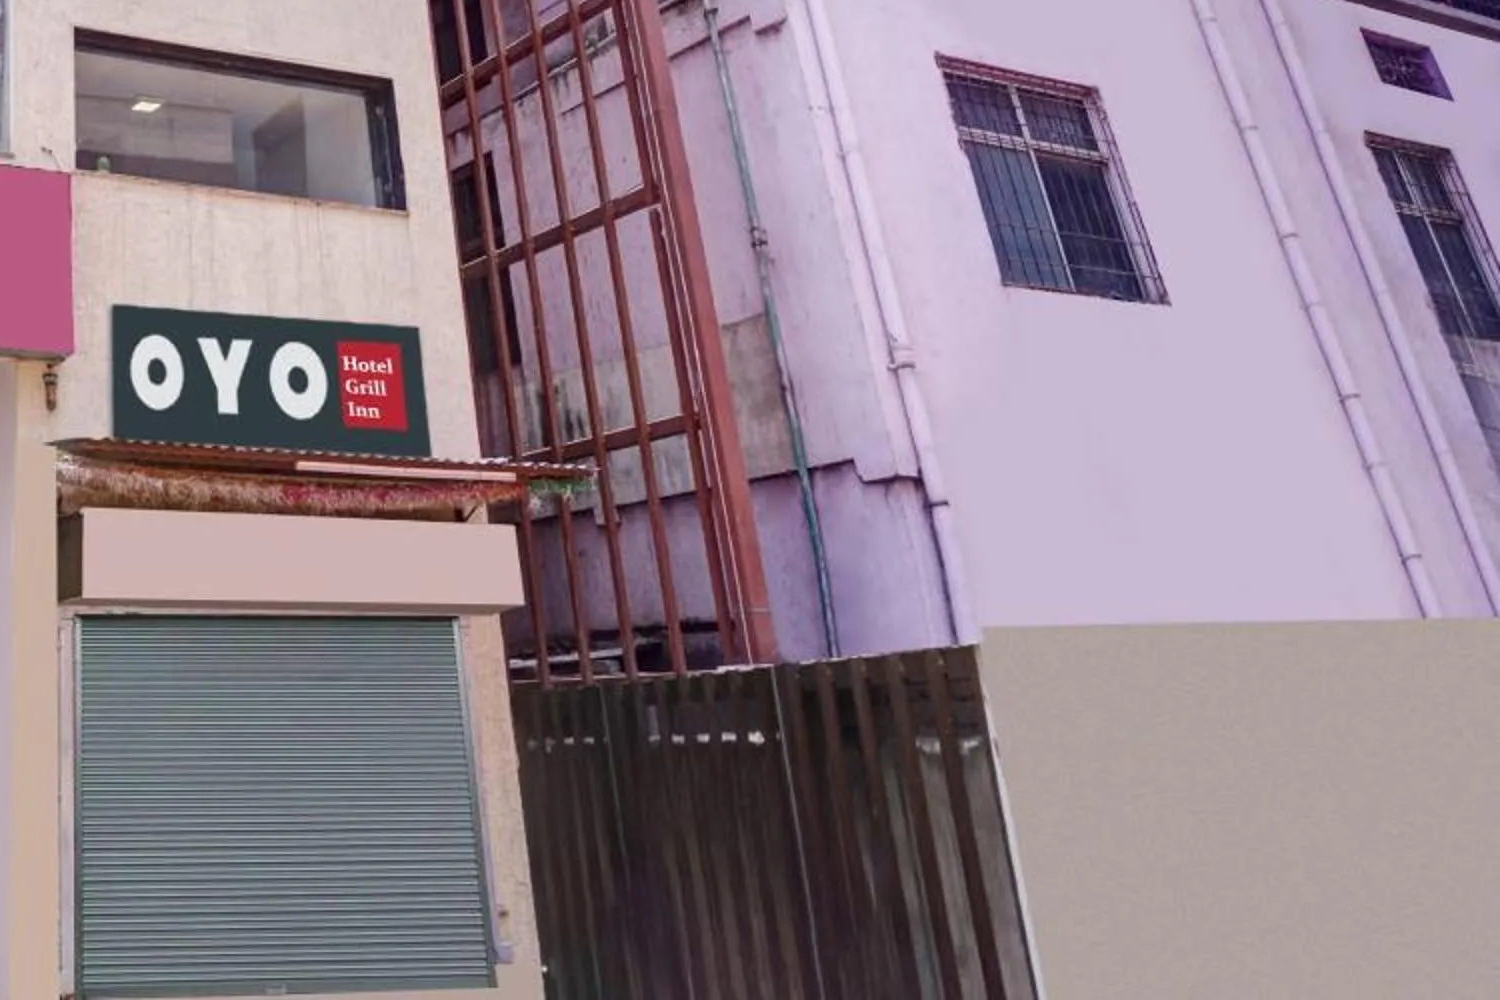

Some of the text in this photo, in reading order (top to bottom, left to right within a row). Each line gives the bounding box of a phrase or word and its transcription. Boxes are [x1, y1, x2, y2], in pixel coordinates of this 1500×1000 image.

[342, 355, 393, 375] Hotel
[129, 334, 328, 420] OYO
[345, 378, 388, 397] Grill
[347, 401, 381, 420] Inn
